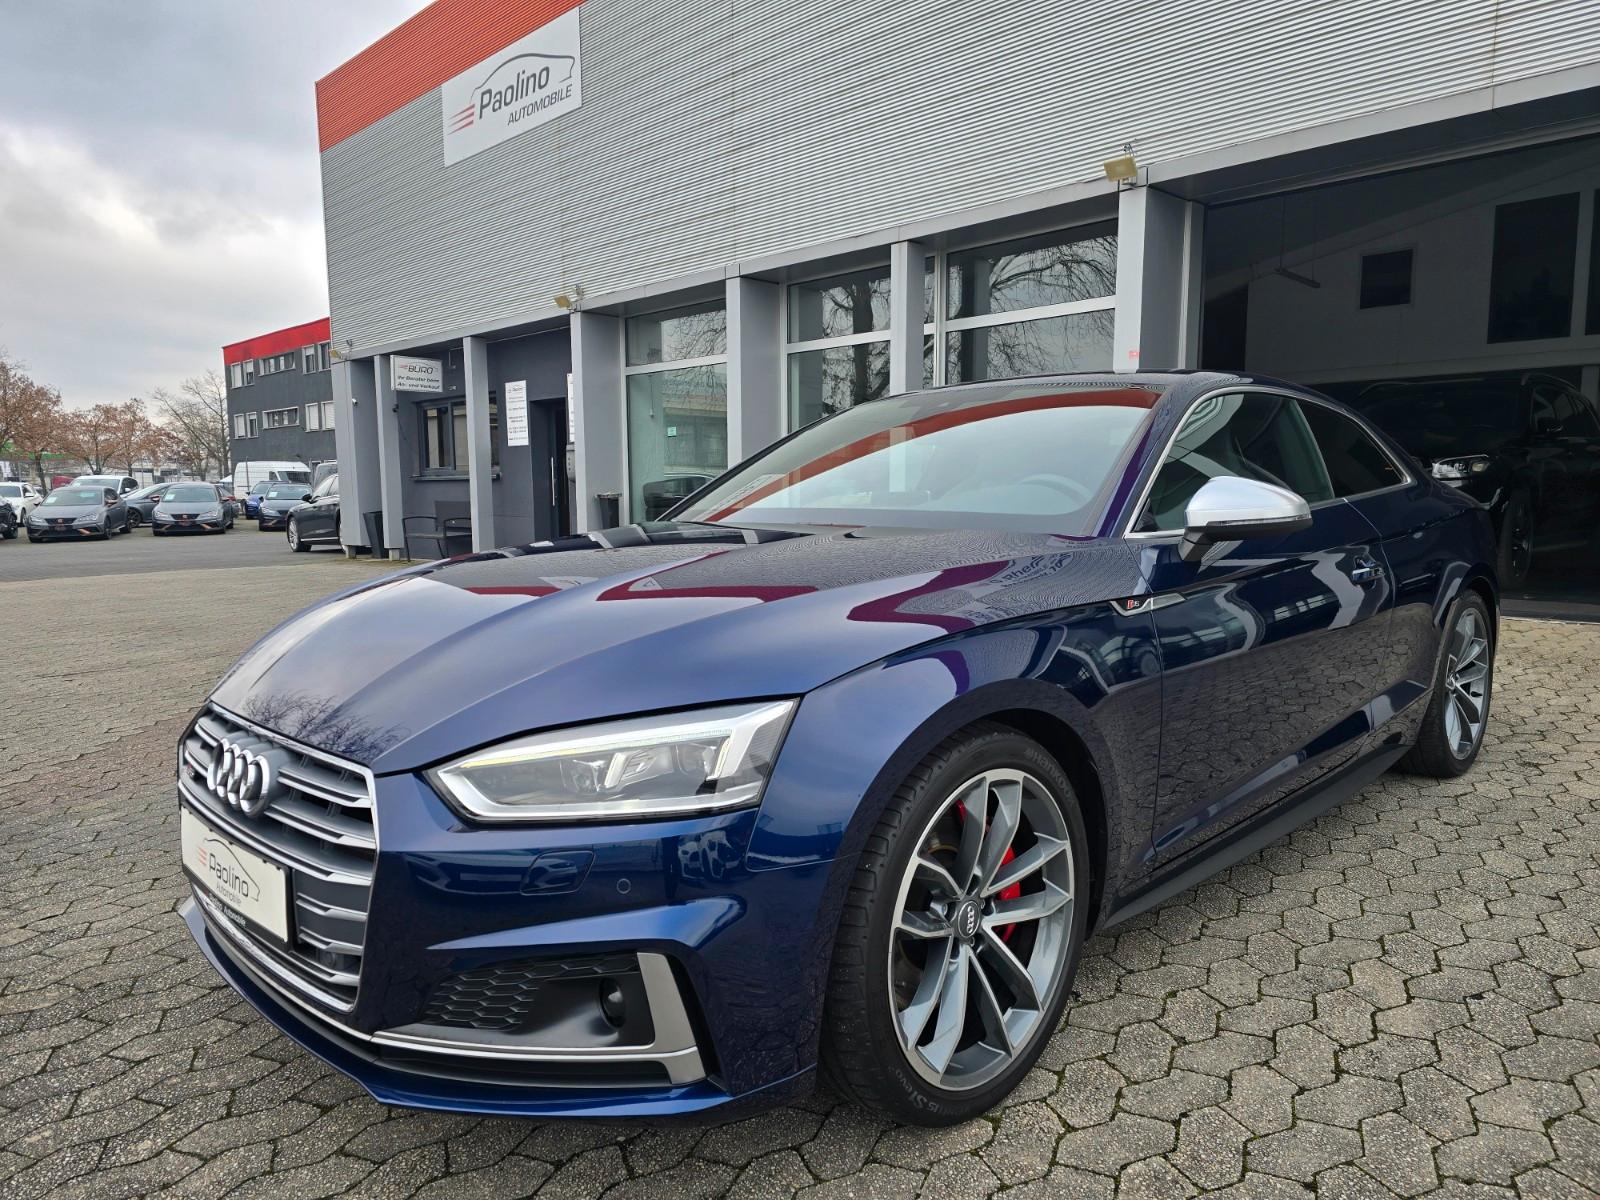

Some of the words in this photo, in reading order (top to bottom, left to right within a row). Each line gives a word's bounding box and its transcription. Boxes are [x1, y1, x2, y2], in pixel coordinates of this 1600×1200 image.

[479, 66, 550, 120] Paolino
[507, 83, 573, 126] AUTOMOBILE
[208, 852, 249, 898] Paolino
[216, 881, 242, 905] Automobile
